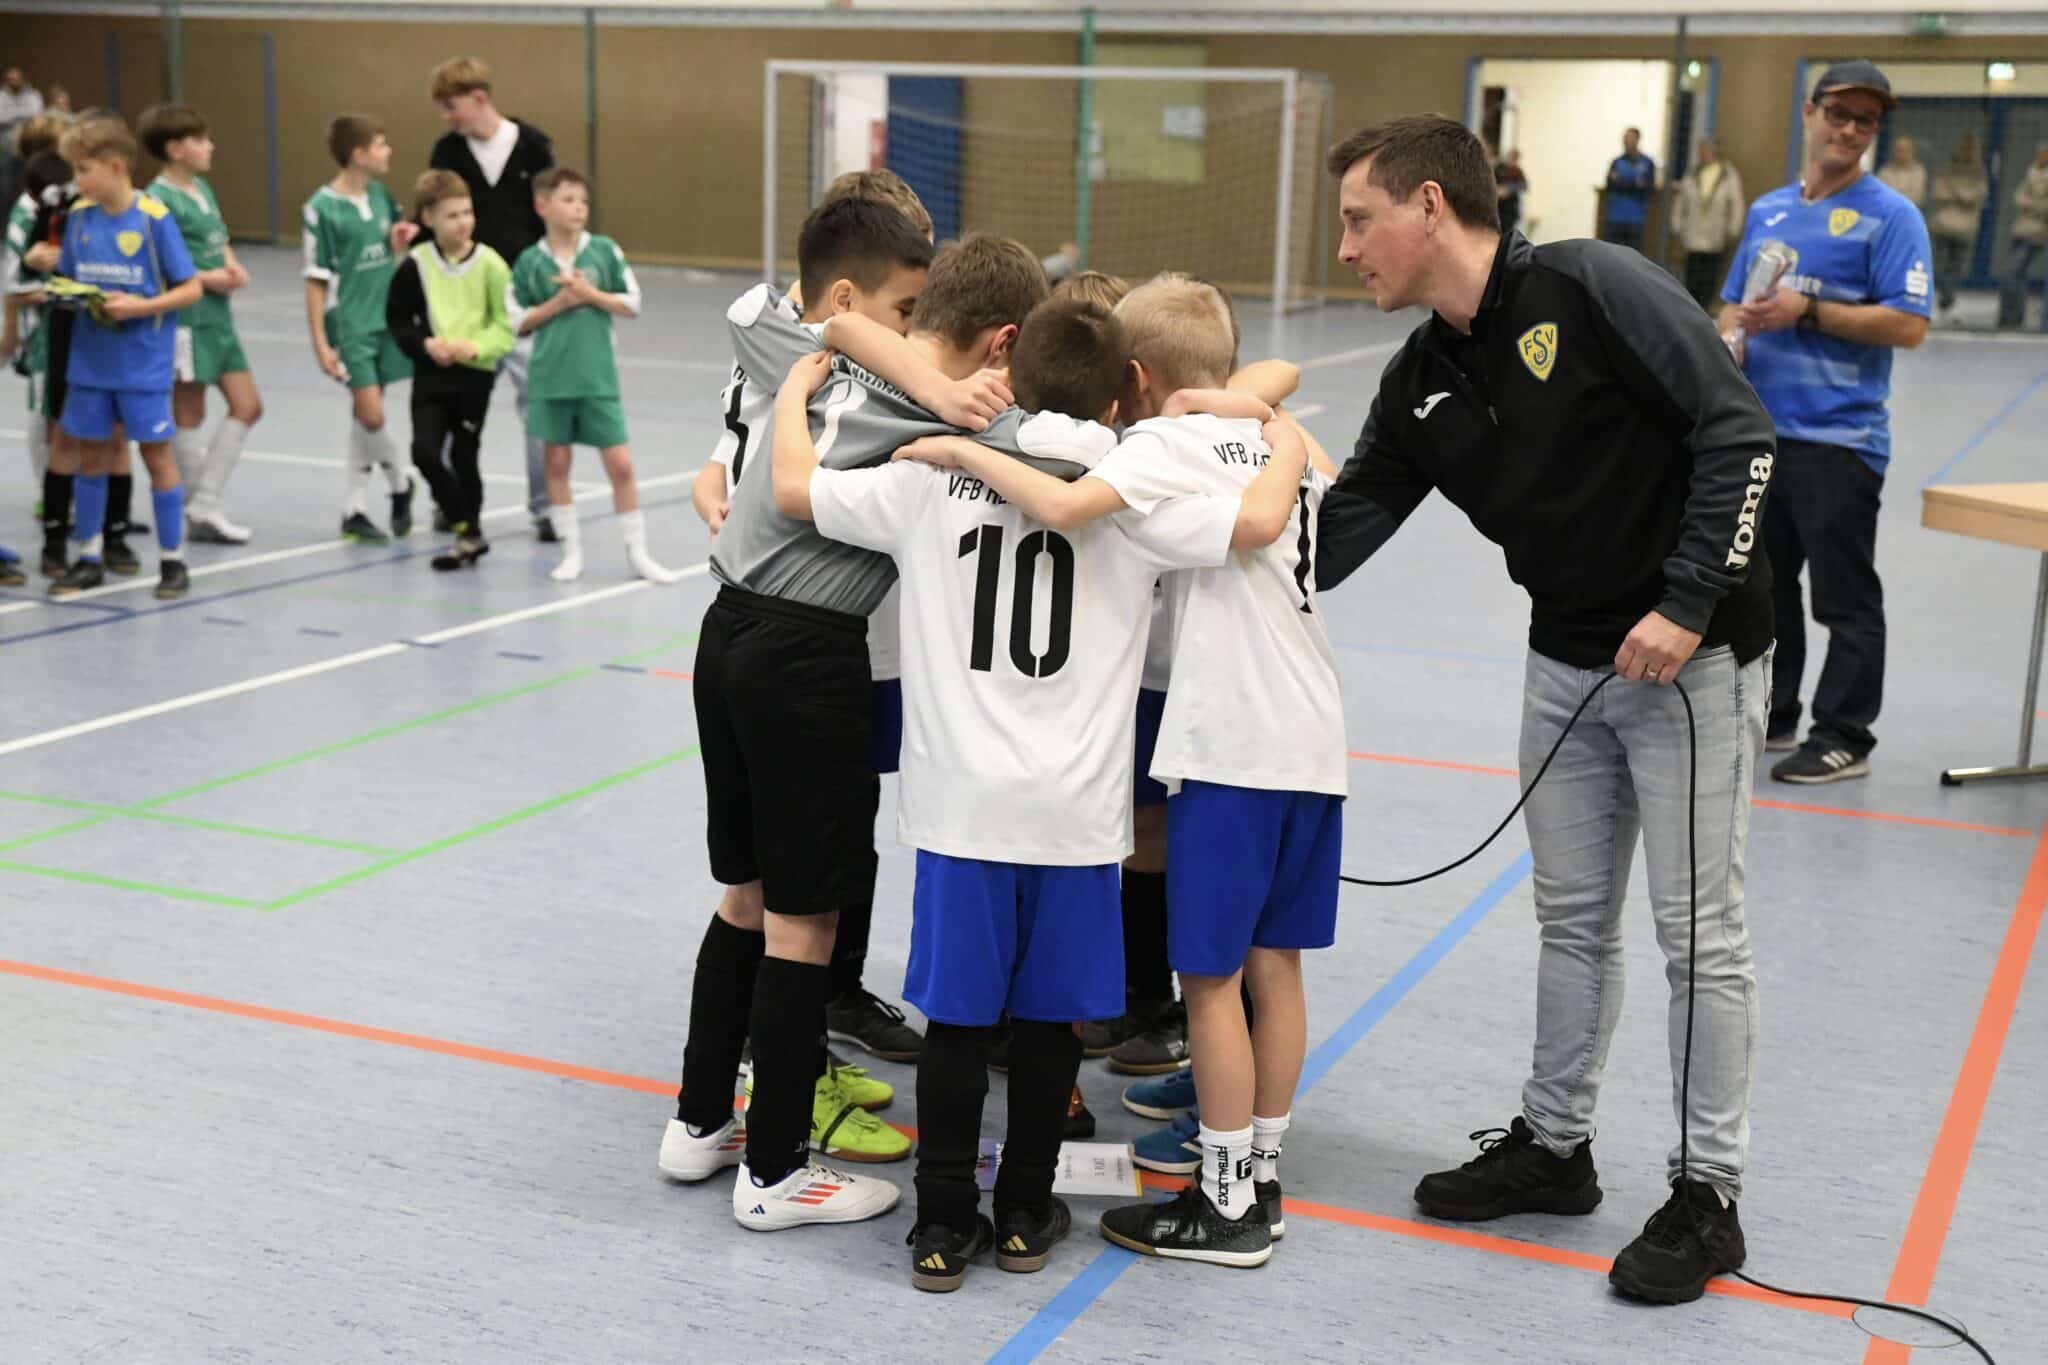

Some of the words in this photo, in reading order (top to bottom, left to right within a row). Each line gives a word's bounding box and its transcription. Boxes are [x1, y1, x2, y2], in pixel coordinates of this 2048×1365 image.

[949, 475, 984, 501] VFB
[1213, 442, 1248, 465] VFB
[1725, 453, 1773, 570] Joma
[958, 523, 1075, 678] 10
